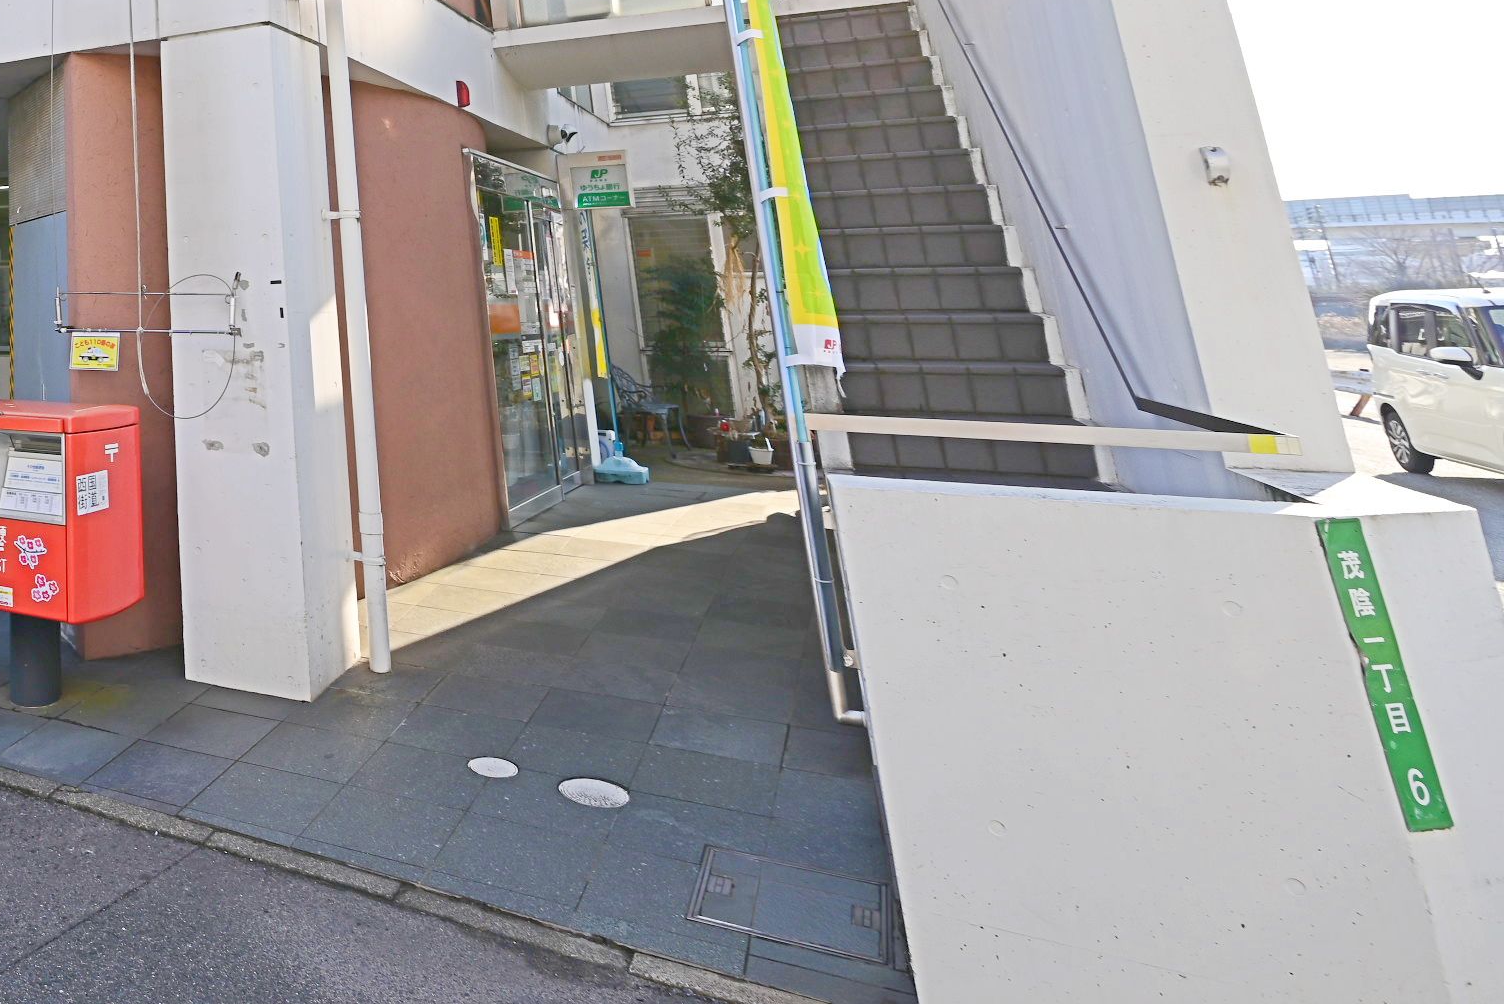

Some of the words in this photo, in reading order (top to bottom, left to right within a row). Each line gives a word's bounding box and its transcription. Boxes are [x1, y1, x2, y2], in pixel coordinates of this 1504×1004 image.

[579, 183, 621, 192] ゆうちょ銀行
[582, 194, 625, 203] ATMコーナー
[1337, 550, 1412, 734] 茂陰一丁目
[1407, 767, 1431, 806] 6
